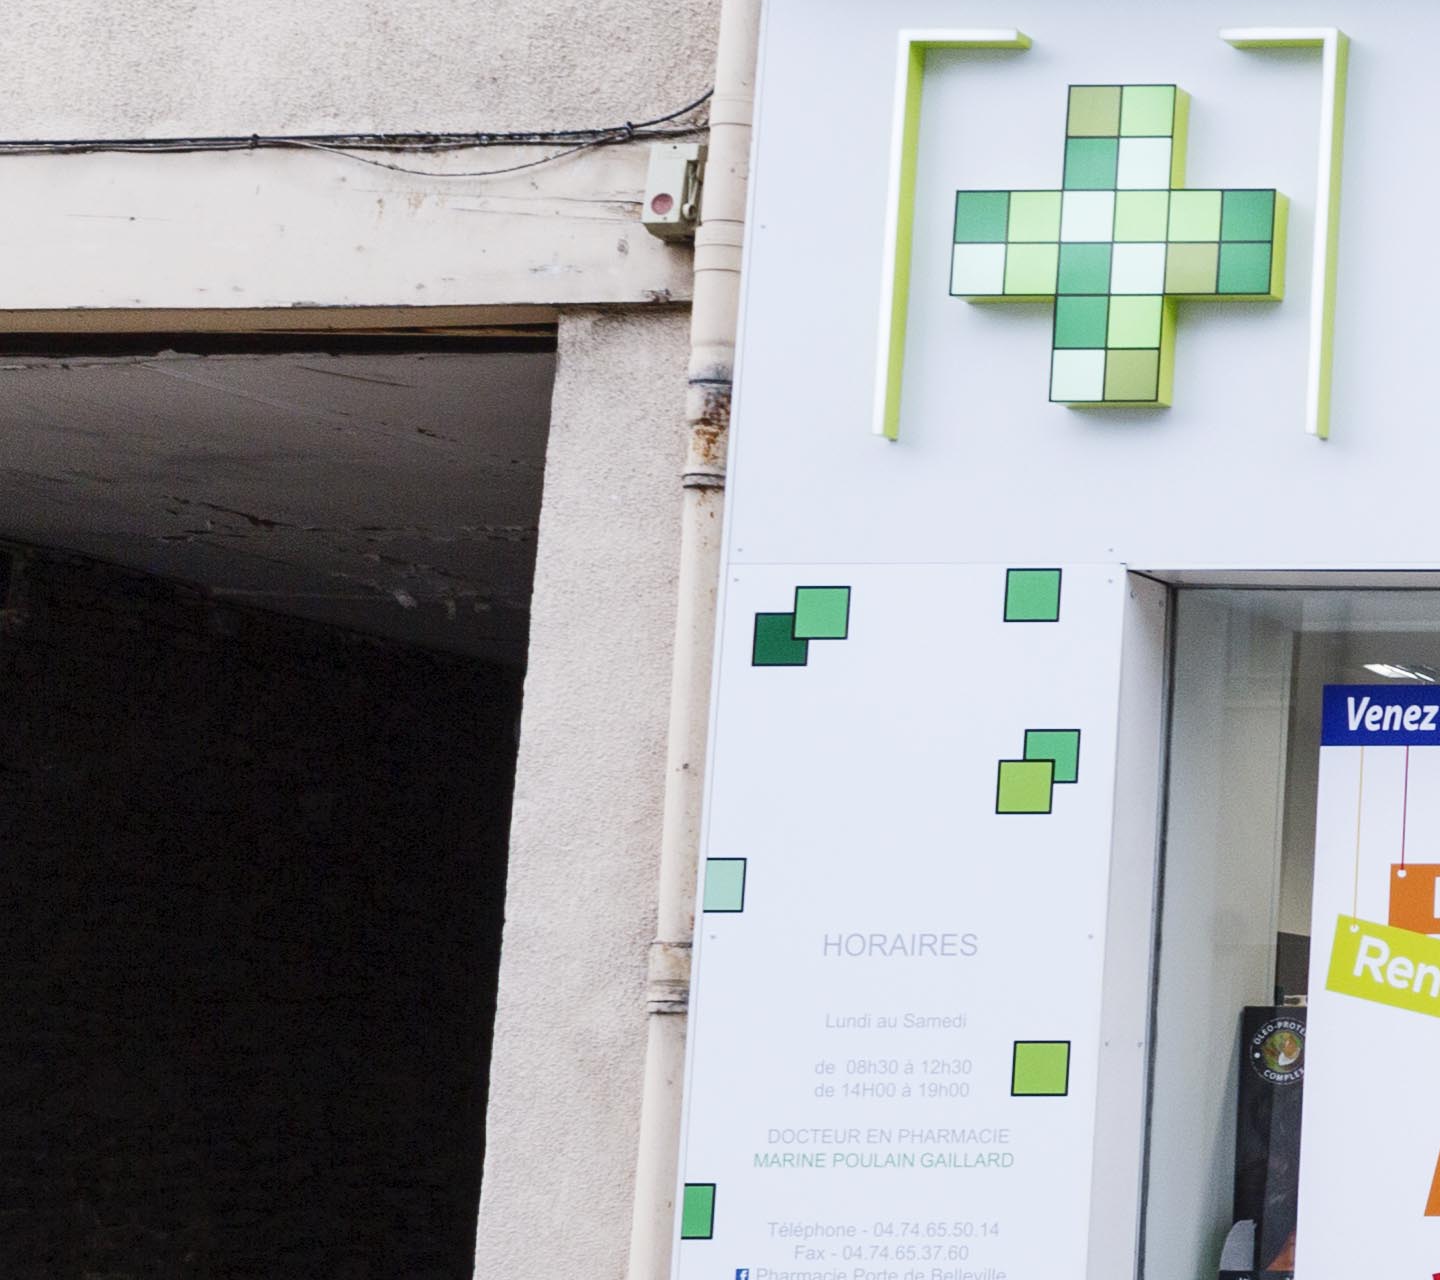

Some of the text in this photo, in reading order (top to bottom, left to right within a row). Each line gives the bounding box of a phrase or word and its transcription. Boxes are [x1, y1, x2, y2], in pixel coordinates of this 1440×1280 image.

[1346, 697, 1437, 733] Venez
[823, 932, 979, 957] HORAIRES
[824, 1012, 967, 1030] Lundi au Samedi
[813, 1056, 973, 1076] de 08h30 à 12h30
[813, 1079, 971, 1099] de 14H00 à 19h00
[767, 1127, 1011, 1145] DOCTEUR EN PHARMACIE
[753, 1151, 1015, 1169] MARINE POULAIN GAILLARD
[767, 1221, 857, 1242] Téléphone
